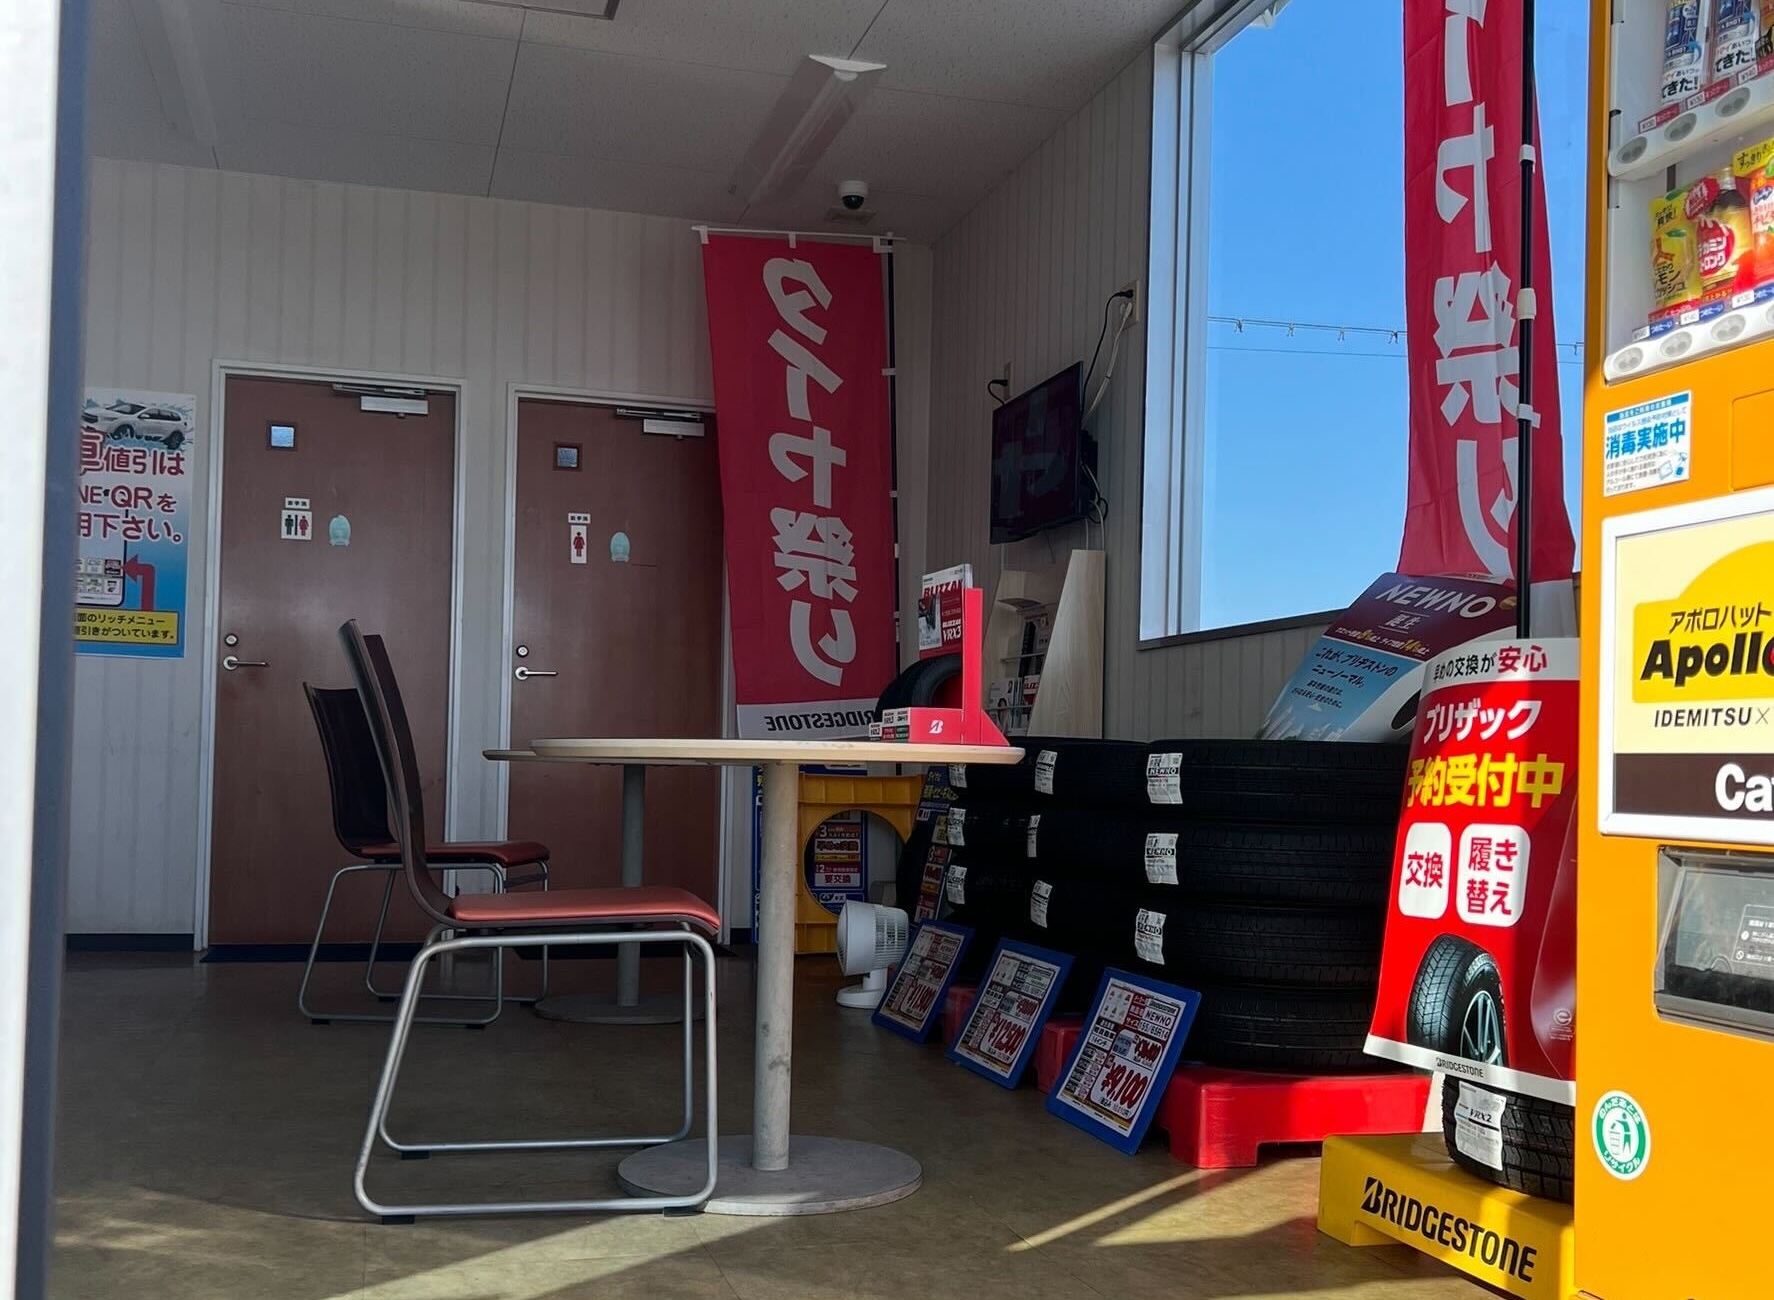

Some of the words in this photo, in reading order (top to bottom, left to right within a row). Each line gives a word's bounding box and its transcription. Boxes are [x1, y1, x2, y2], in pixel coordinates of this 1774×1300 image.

[1606, 417, 1686, 460] 消毒実施中
[74, 612, 165, 625] 面のリッチメニュー
[1375, 584, 1496, 618] NEWNO
[1668, 602, 1773, 635] アポロハット
[1423, 698, 1542, 744] ブリザック
[1654, 707, 1752, 728] IDEMITSU
[1407, 752, 1565, 808] 予約受付中
[1714, 763, 1774, 812] Ca
[1404, 852, 1444, 890] 交換
[1468, 836, 1518, 872] 履き
[1466, 879, 1512, 916] 替え
[1144, 1009, 1172, 1027] NEWNO
[1436, 1057, 1484, 1078] BRIDGESTONE
[1470, 1108, 1492, 1122] VRX2
[1603, 1151, 1641, 1174] リサイクル
[1360, 1176, 1538, 1283] BRIDGESTONE
